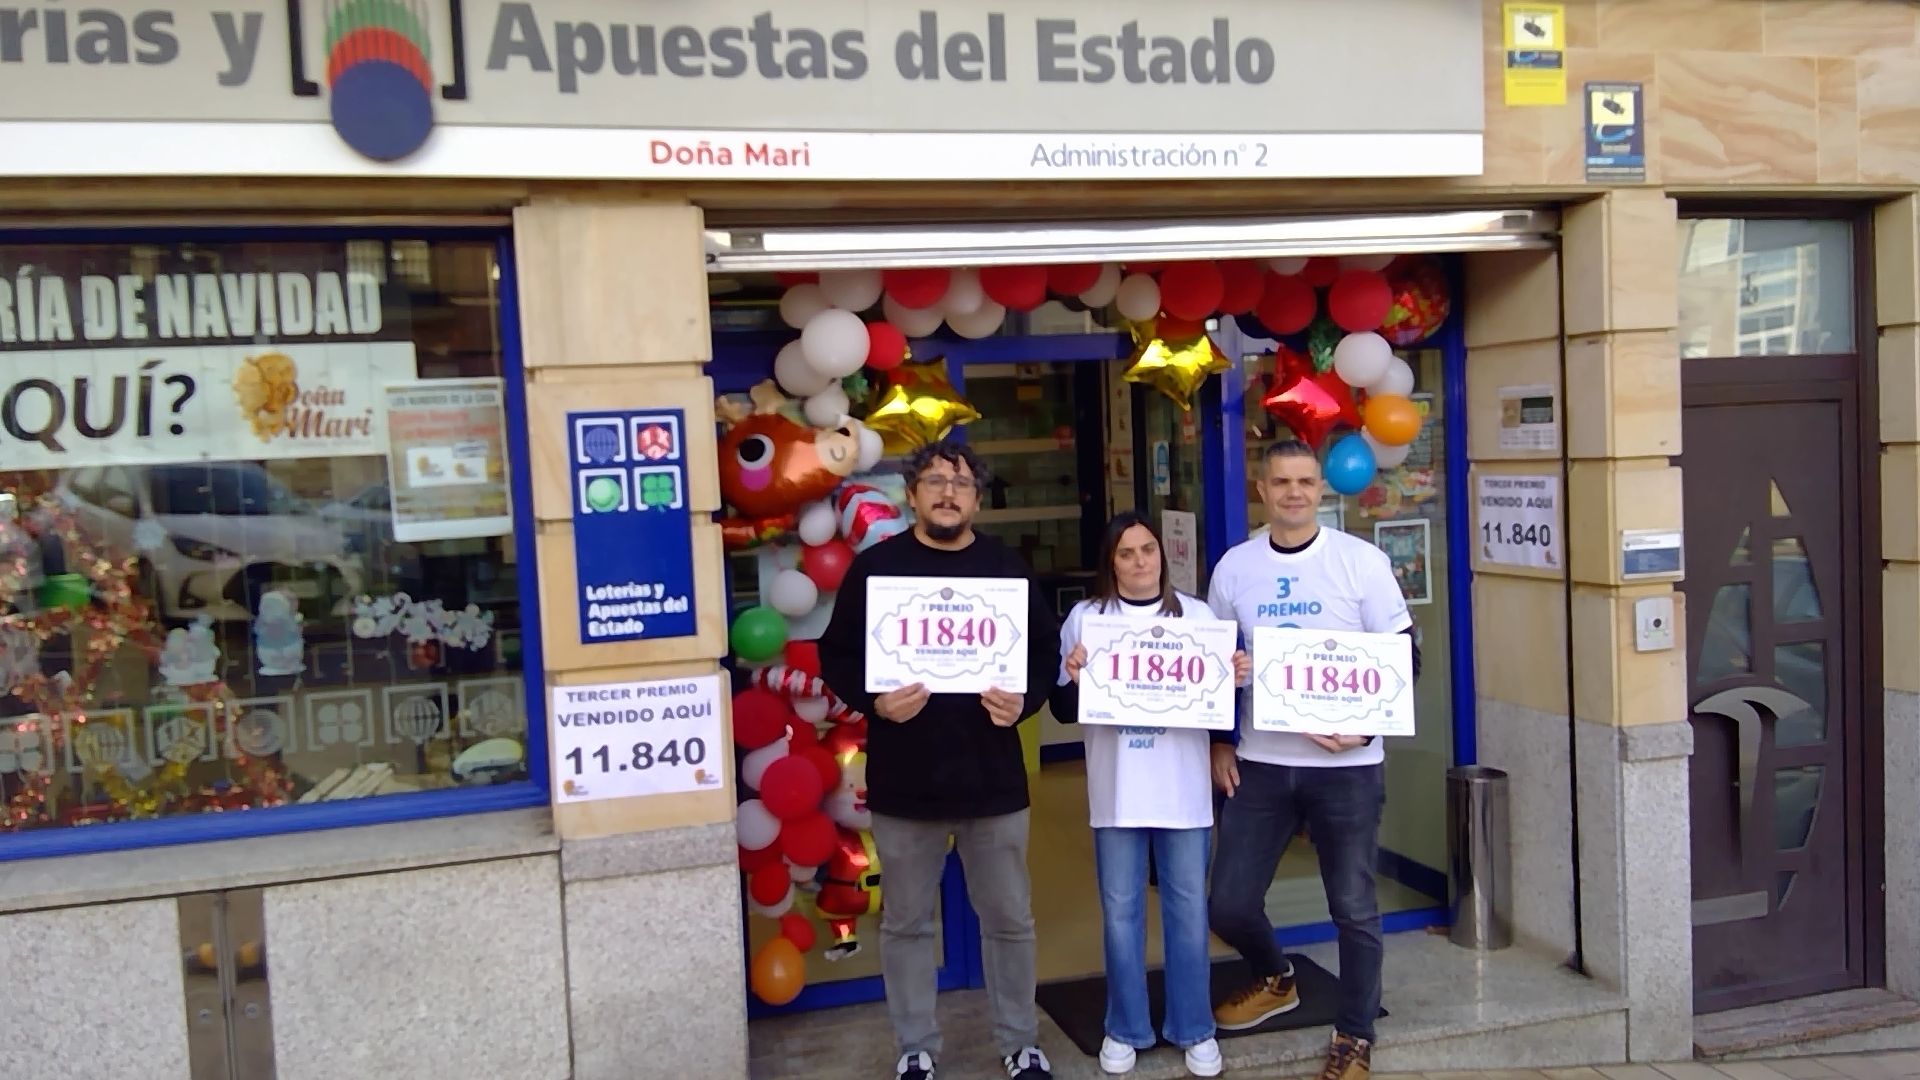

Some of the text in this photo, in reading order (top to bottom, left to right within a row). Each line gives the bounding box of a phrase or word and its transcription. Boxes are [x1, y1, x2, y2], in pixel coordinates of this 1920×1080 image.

[210, 11, 264, 87] y
[485, 1, 869, 94] Apuestas
[895, 10, 1007, 82] del
[1035, 18, 1276, 85] Estado
[650, 140, 810, 167] Doña Mari
[1030, 142, 1217, 167] Administración
[1255, 142, 1268, 167] 2
[81, 273, 149, 340] DE
[155, 272, 382, 338] NAVIDAD
[0, 358, 196, 453] QUÍ?
[285, 406, 373, 438] Mari
[1483, 521, 1551, 547] 11.840
[653, 582, 665, 600] y
[588, 595, 689, 621] Apuestas del
[929, 603, 974, 613] PREMIO
[1257, 601, 1322, 618] PREMIO
[588, 617, 645, 637] Estado
[896, 617, 997, 648] 11840
[1139, 640, 1184, 651] PREMIO
[1313, 653, 1358, 663] PREMIO
[1108, 653, 1205, 684] 11840
[1283, 664, 1381, 696] 11840
[566, 683, 698, 703] TERCER PREMIO
[558, 698, 712, 728] VENDIDO AQUÍ
[1128, 735, 1155, 749] AQUÍ
[565, 737, 706, 775] 11.840
